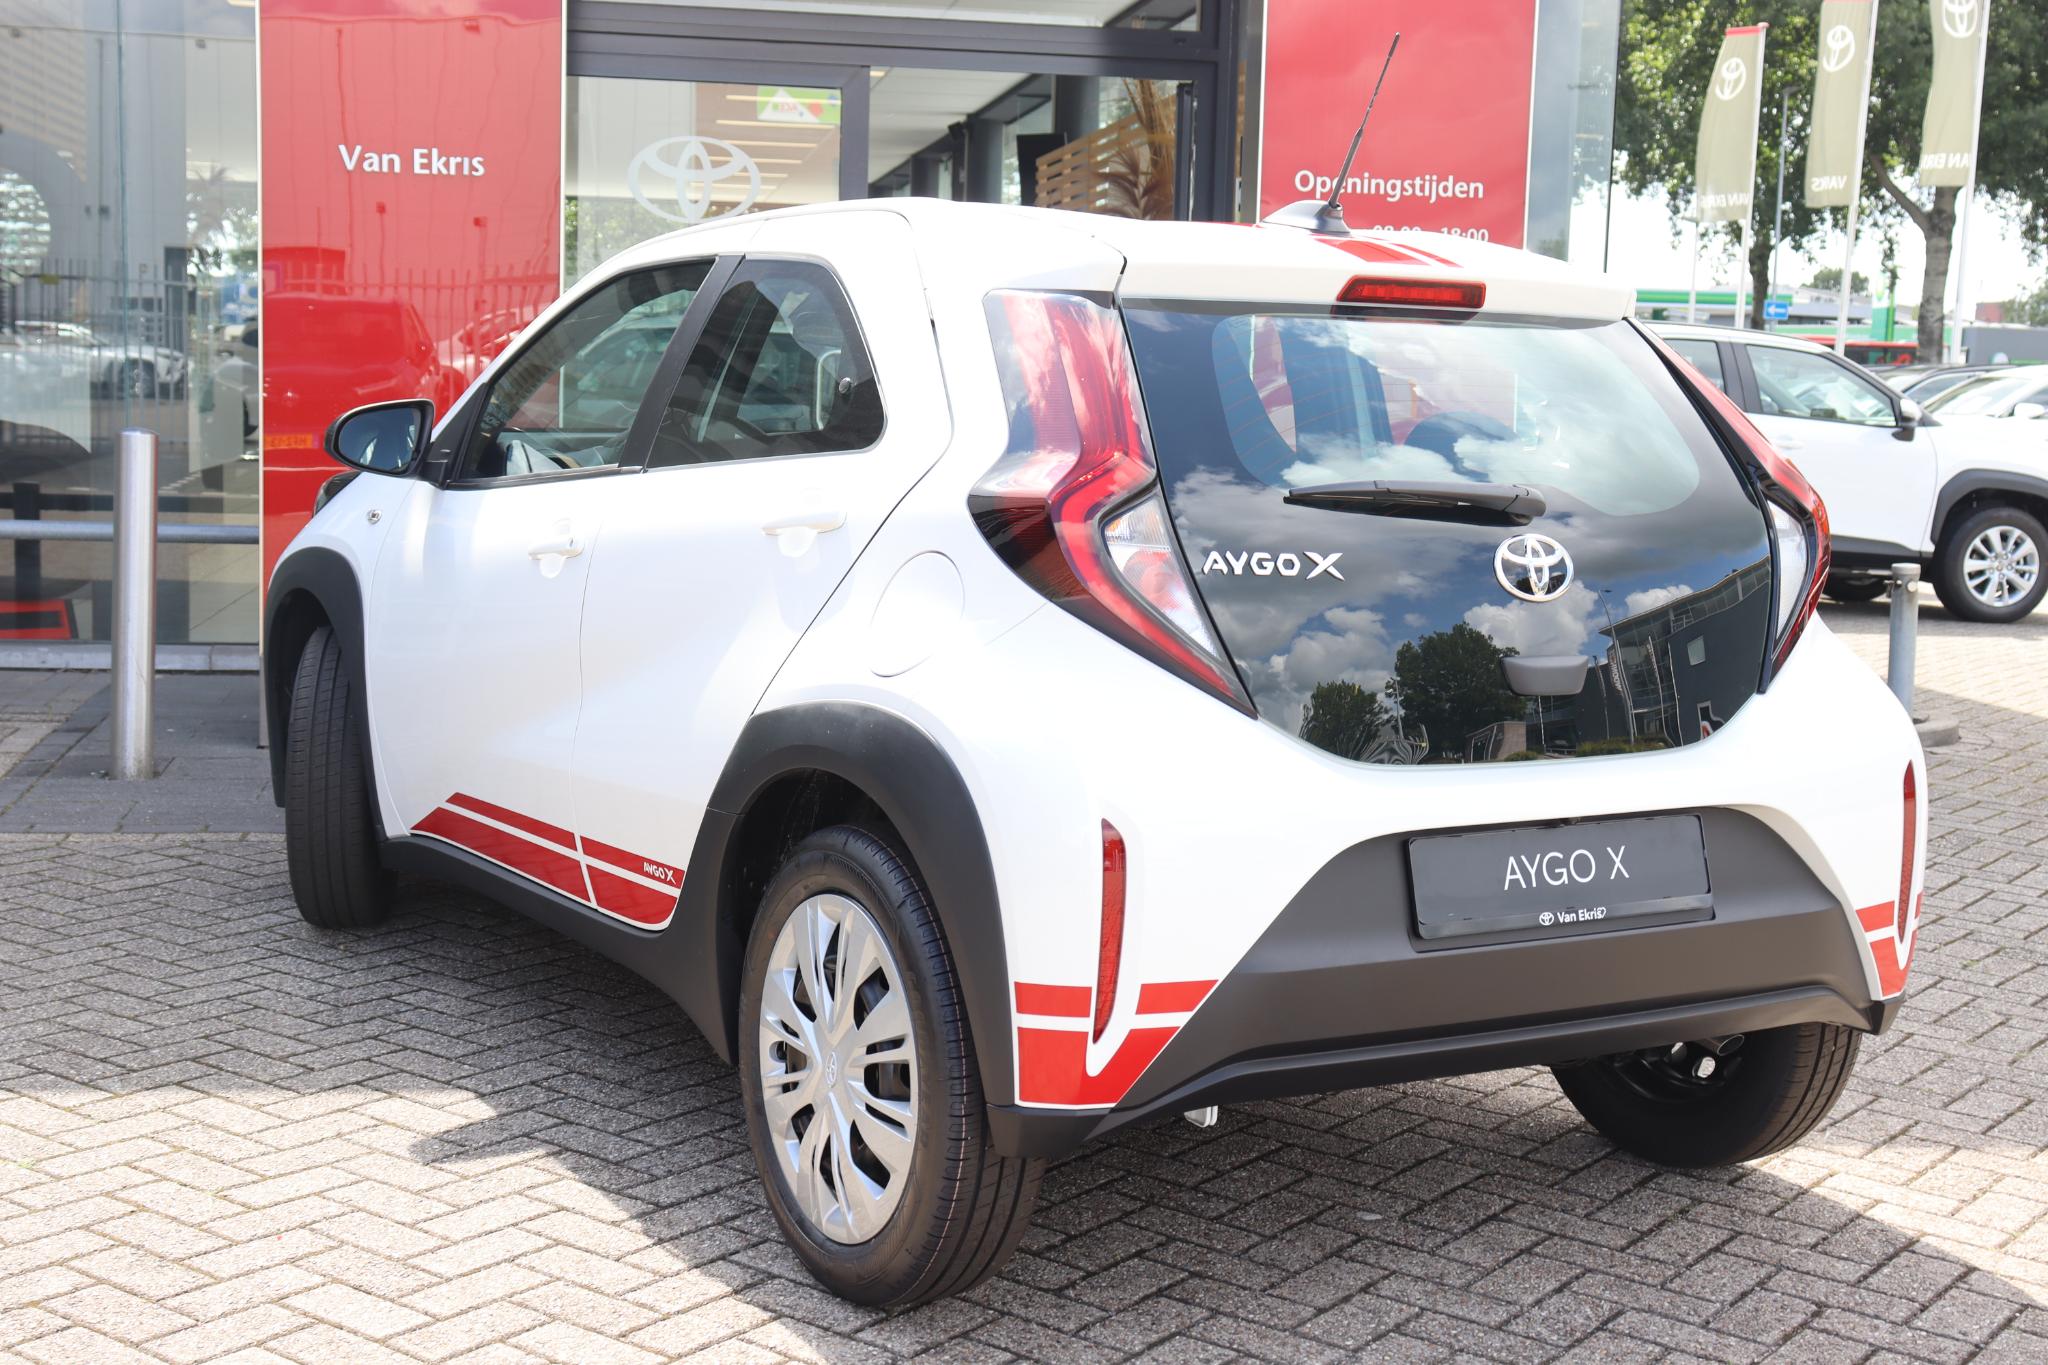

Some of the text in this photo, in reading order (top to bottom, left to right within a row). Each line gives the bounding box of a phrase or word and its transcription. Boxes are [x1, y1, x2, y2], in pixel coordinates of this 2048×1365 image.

[338, 144, 485, 176] Van Ekris
[1295, 170, 1484, 203] Openingstijden
[1202, 550, 1345, 581] AYGO X
[1504, 845, 1630, 891] AYGO X
[1557, 907, 1602, 923] Van Ekris
